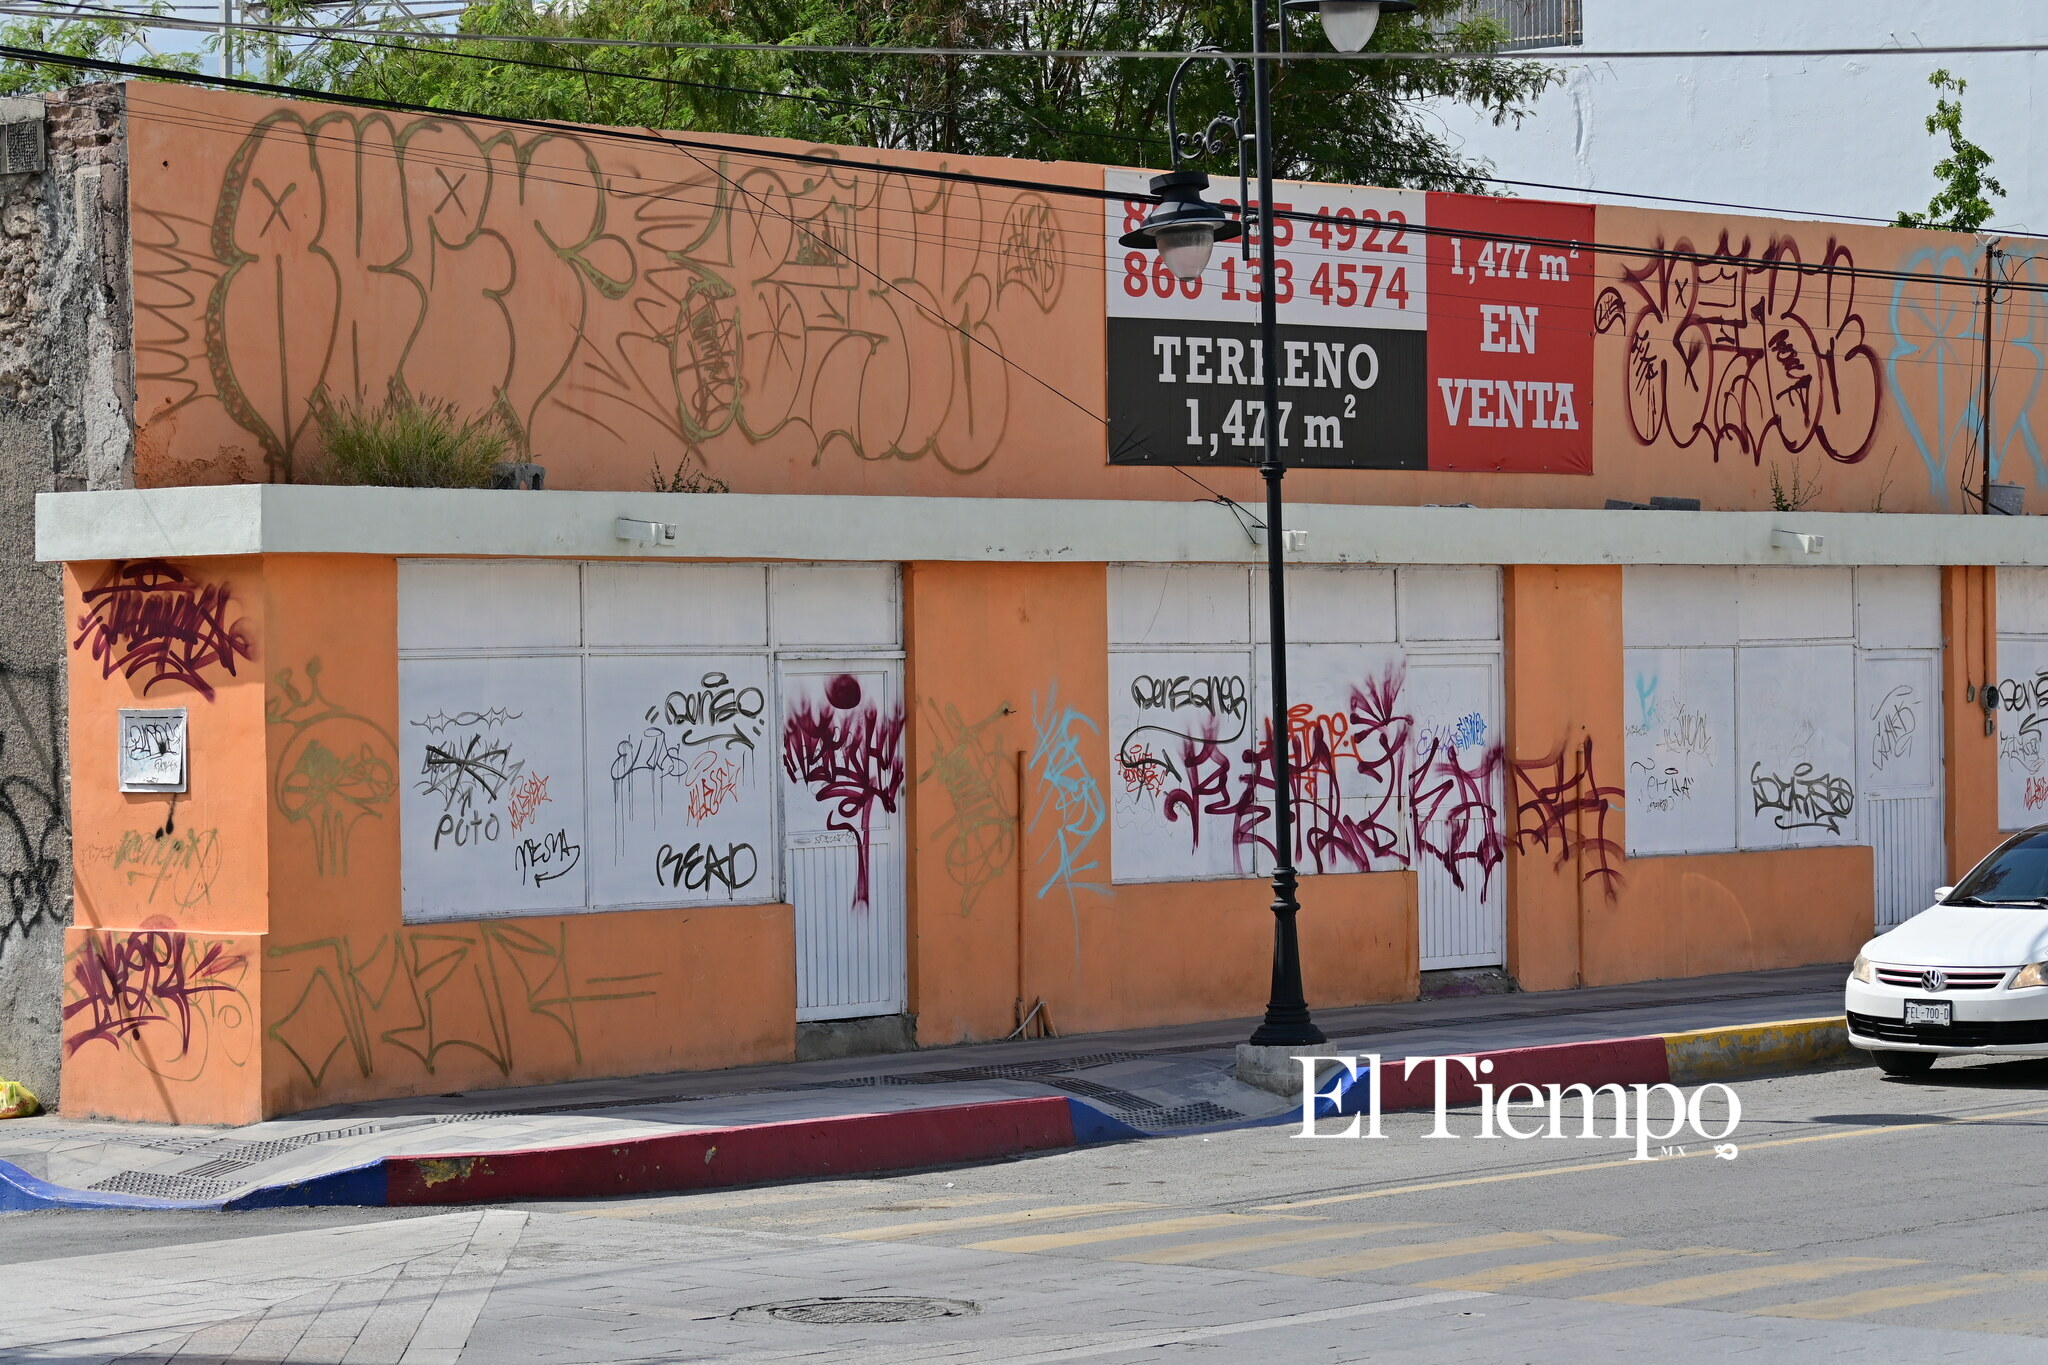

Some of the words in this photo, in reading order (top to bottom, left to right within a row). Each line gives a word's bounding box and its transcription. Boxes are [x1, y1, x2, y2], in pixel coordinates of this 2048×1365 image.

[1309, 206, 1408, 255] 4922
[1451, 237, 1532, 285] 1,477
[1309, 262, 1409, 310] 4574
[1480, 304, 1539, 354] EN
[1437, 377, 1579, 430] VENTA
